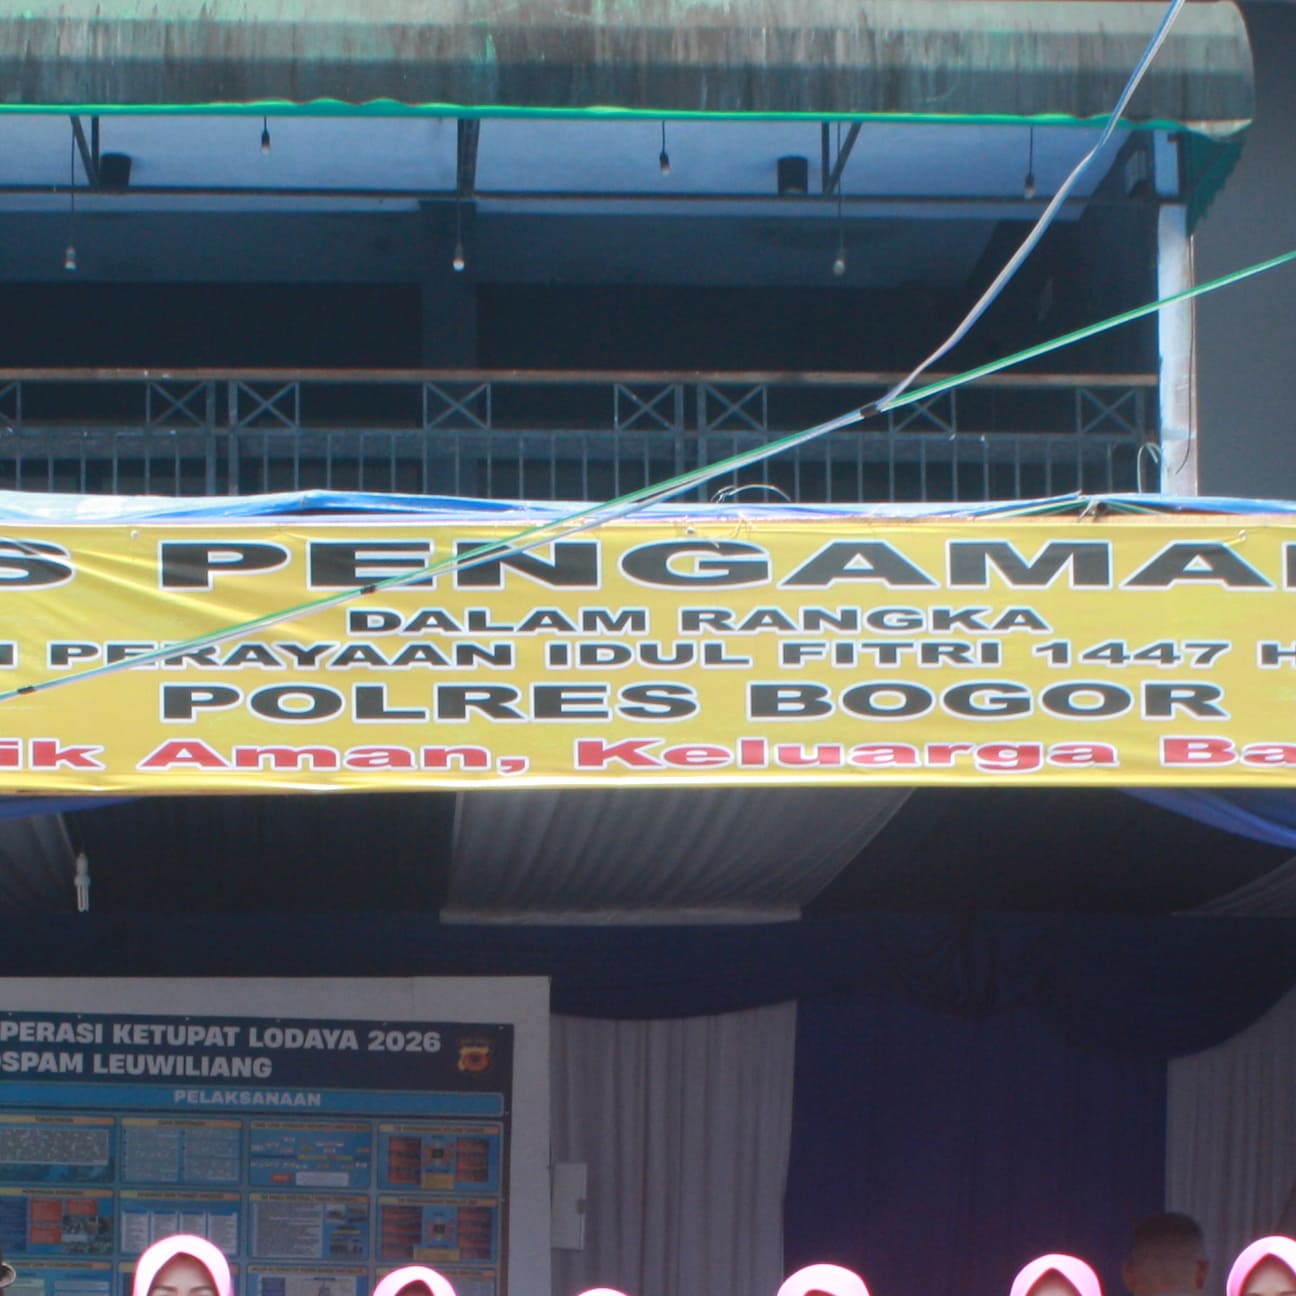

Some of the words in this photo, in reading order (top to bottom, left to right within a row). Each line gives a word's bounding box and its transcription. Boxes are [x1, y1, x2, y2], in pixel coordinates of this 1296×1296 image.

[349, 608, 647, 634] DALAM
[681, 607, 1052, 633] RANGKA
[48, 640, 514, 669] PERAYAAN
[547, 641, 751, 669] IDUL
[779, 640, 1002, 668] FITRI
[1033, 641, 1230, 668] 1447
[160, 683, 698, 723] POLRES
[747, 680, 1230, 721] BOGOR
[137, 738, 529, 776] Aman,
[575, 737, 1119, 773] Keluarga
[112, 1023, 240, 1047] KETUPAT
[248, 1027, 359, 1051] LODAYA
[366, 1030, 442, 1053] 2026
[93, 1053, 273, 1079] LEUWILIANG
[173, 1090, 322, 1108] PELAKSANAAN
